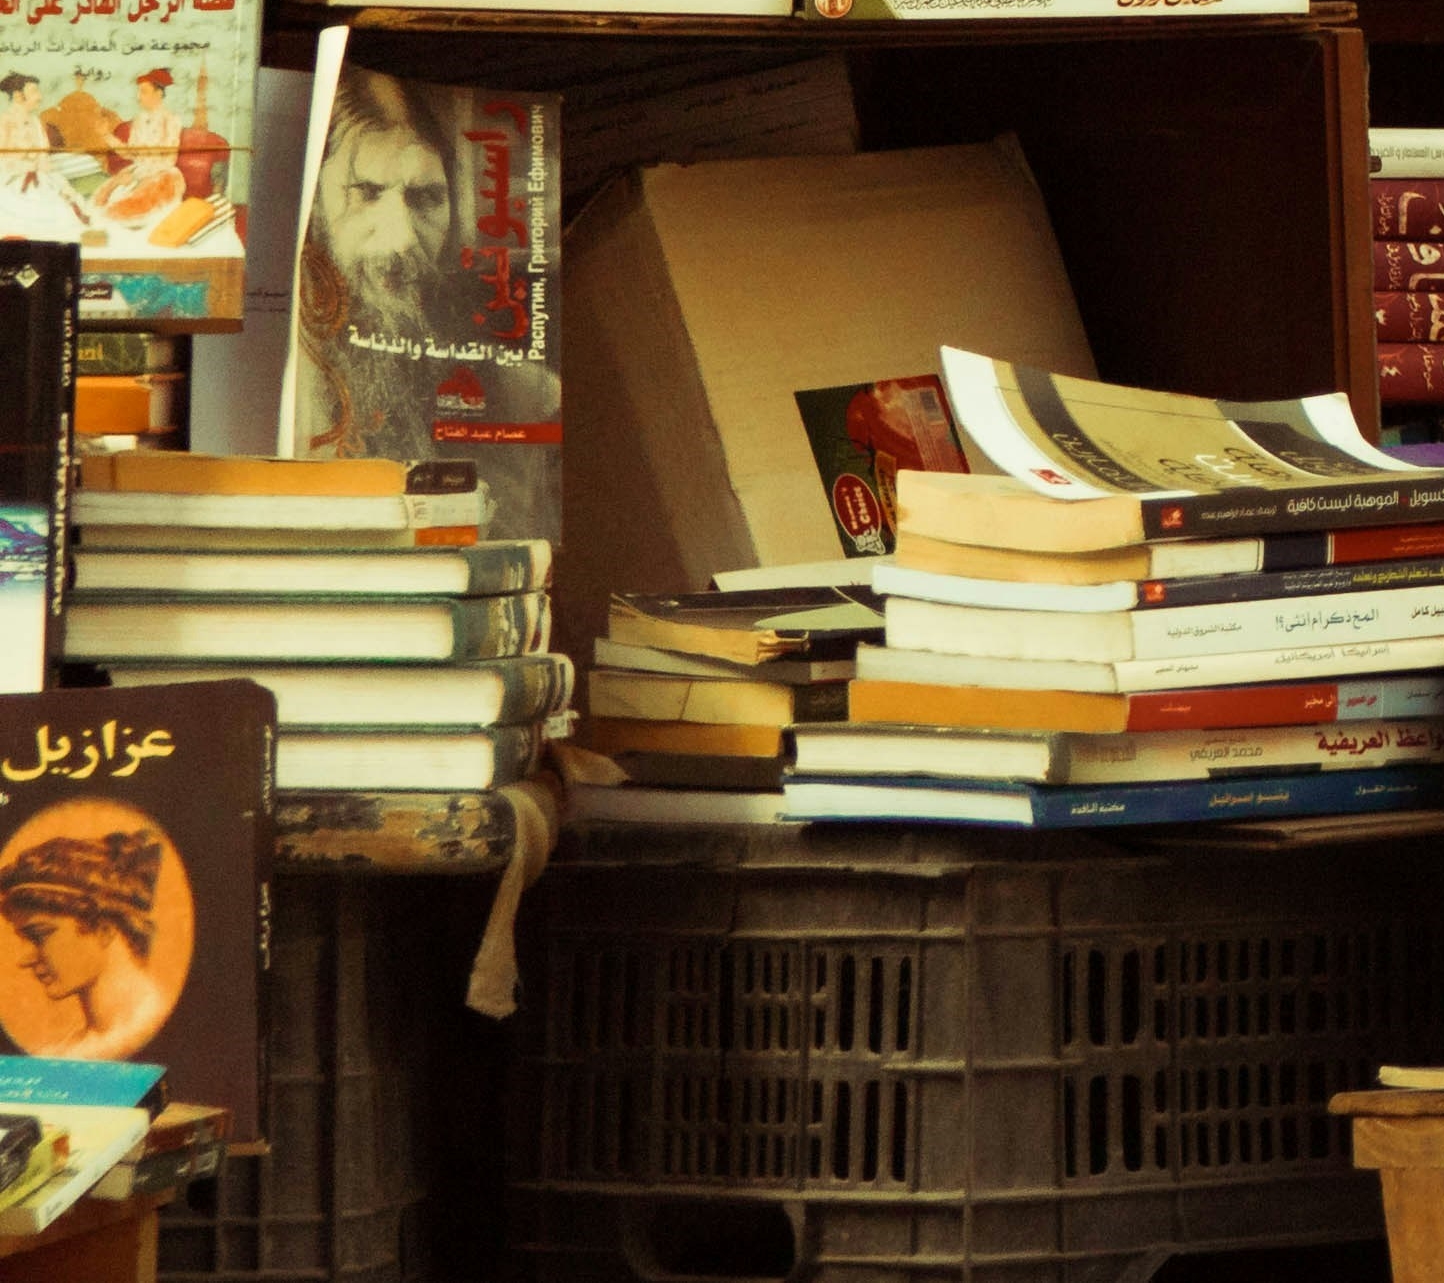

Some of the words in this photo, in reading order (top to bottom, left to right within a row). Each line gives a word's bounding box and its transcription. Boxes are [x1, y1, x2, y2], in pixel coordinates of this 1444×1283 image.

[0, 41, 42, 58] الرياض
[121, 39, 146, 55] من
[151, 37, 211, 56] مجموعة
[73, 65, 112, 82] رواية
[528, 104, 546, 193] Ефимович
[461, 100, 529, 340] راسبوتين
[528, 194, 547, 274] Григорий
[528, 278, 549, 362] Распутин,
[348, 324, 423, 359] والدناسة
[424, 337, 493, 362] القداسة
[496, 346, 524, 367] بين
[1286, 496, 1317, 517] كافية
[1317, 493, 1355, 514] ليست
[1355, 489, 1401, 512] الموهبة
[1328, 612, 1353, 630] ذكر
[1352, 608, 1380, 630] المخ
[2, 719, 176, 782] عزازيل
[1233, 746, 1263, 759] محمد
[1318, 731, 1390, 754] العريفية
[1190, 746, 1231, 762] العريفي
